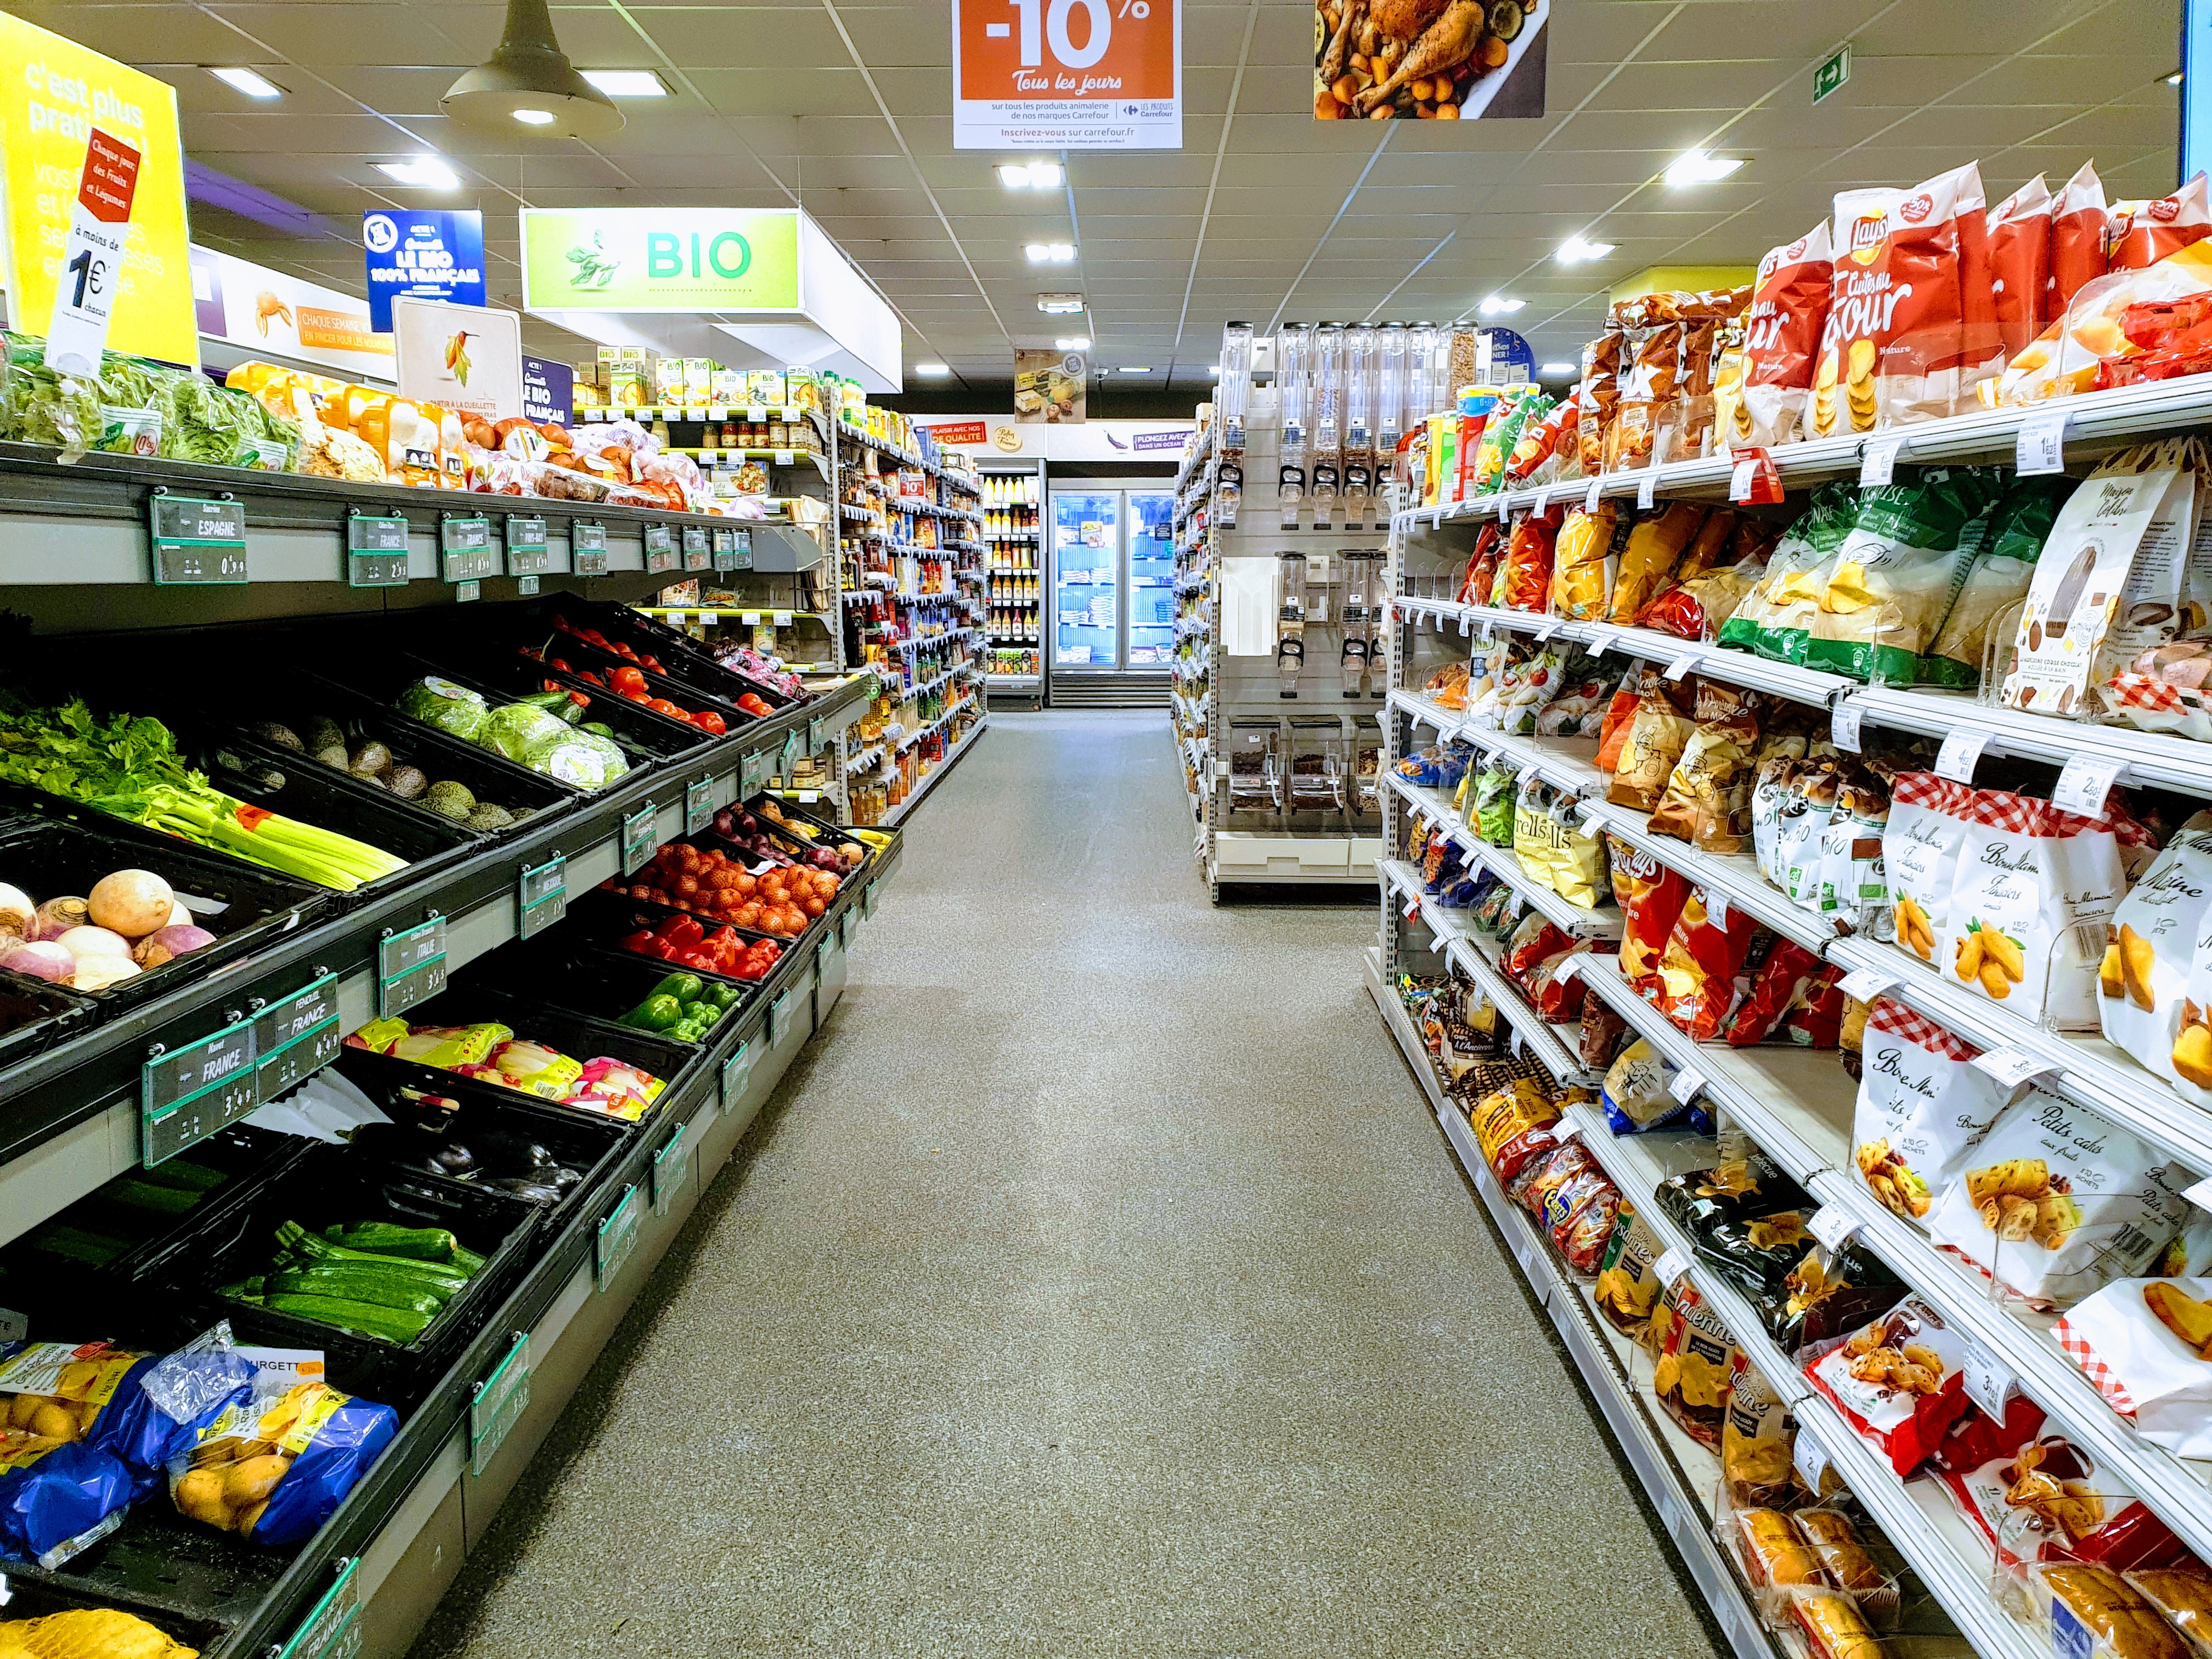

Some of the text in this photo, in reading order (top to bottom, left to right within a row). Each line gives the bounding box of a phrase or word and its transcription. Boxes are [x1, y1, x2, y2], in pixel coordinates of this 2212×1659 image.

[1012, 69, 1122, 96] Tous les jours
[25, 61, 144, 128] c'est plus
[1036, 102, 1068, 111] produits
[1037, 113, 1071, 121] marques
[1001, 128, 1066, 137] Inscrivez-vous
[1084, 128, 1135, 137] carrefour.fr
[92, 139, 119, 162] Chaque
[92, 163, 127, 188] des Fruits
[86, 184, 94, 194] et
[76, 224, 81, 235] à
[83, 229, 106, 246] moins
[109, 239, 119, 251] de
[647, 232, 751, 279] BIO
[1876, 272, 1892, 289] au
[302, 313, 330, 330] CHAQUE
[1880, 345, 1911, 354] Nature
[1757, 361, 1783, 371] Nature
[532, 386, 551, 405] BIO
[465, 402, 496, 410] CUEILLETTE
[526, 403, 566, 424] FRANÇAIS
[946, 432, 981, 442] QUALITÉ
[1137, 435, 1167, 443] PLONGEZ
[2100, 482, 2134, 499] Maison
[198, 520, 236, 537] ESPAGNE
[380, 535, 401, 549] FRANCE
[1673, 922, 1690, 945] ature
[417, 938, 436, 960] ITALIE
[295, 990, 321, 1012] FENOUIL
[291, 1002, 326, 1036] FRANCE
[202, 1048, 241, 1084] FRANCE
[2032, 1106, 2107, 1155] Petits cakes
[2054, 1146, 2079, 1162] fruits
